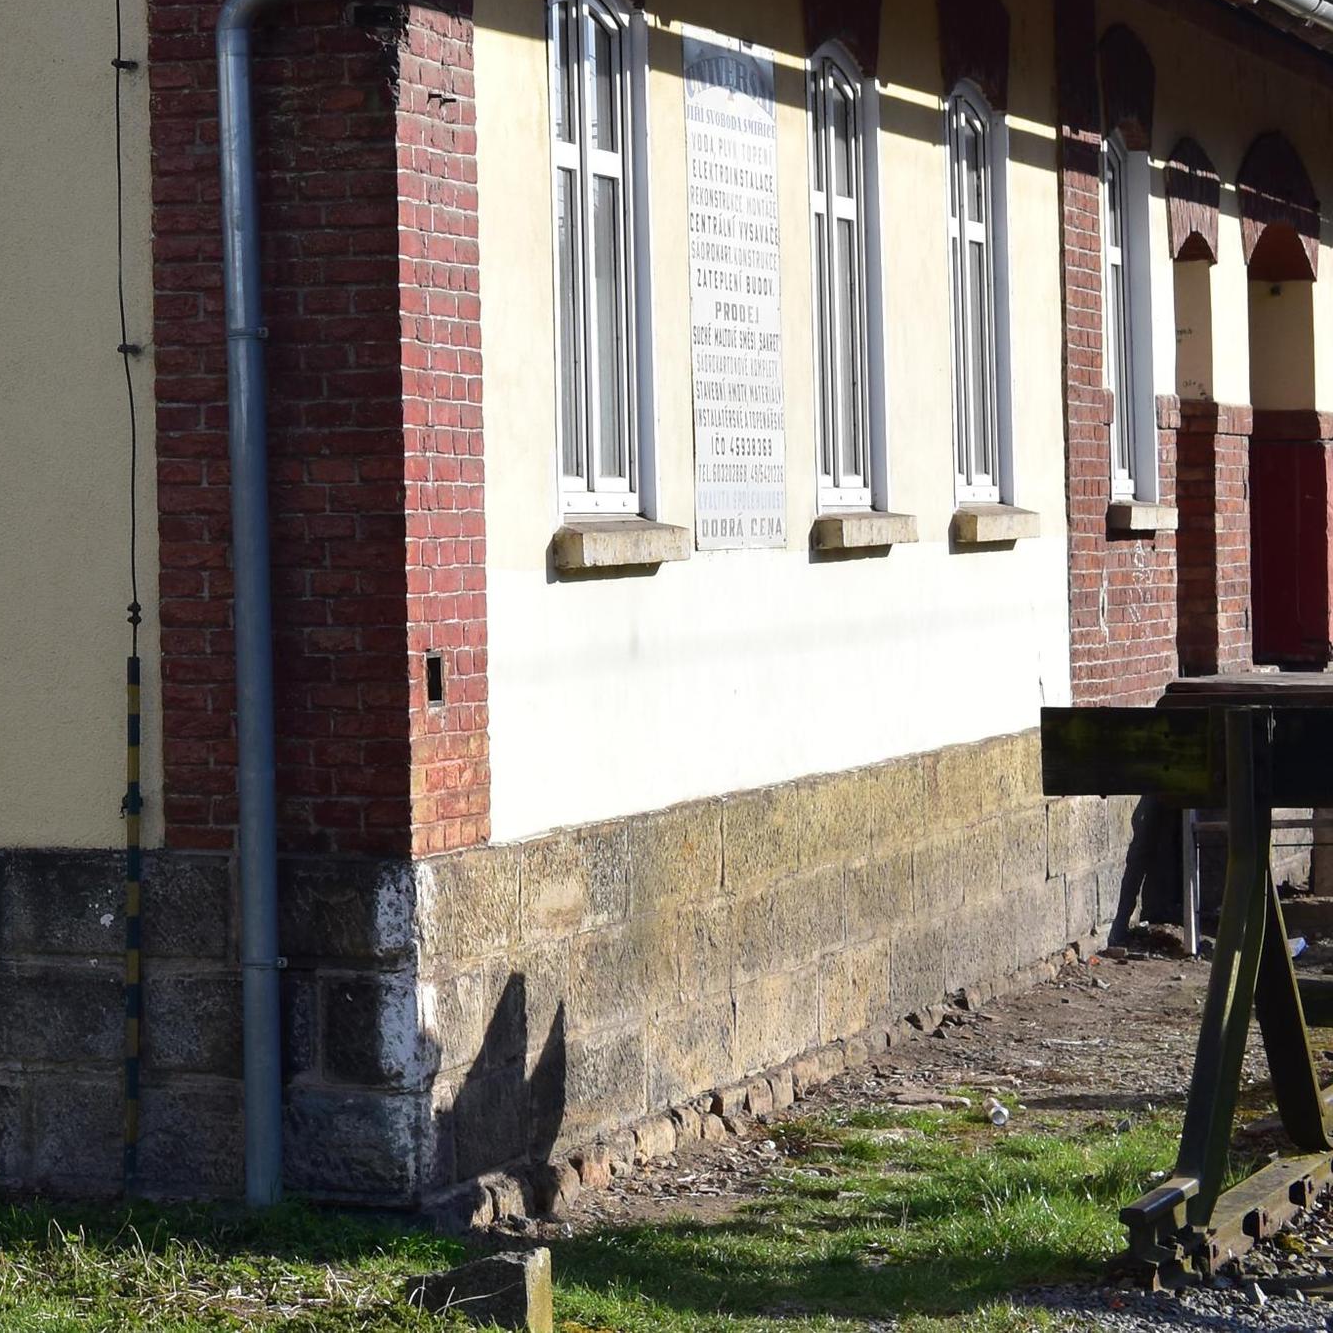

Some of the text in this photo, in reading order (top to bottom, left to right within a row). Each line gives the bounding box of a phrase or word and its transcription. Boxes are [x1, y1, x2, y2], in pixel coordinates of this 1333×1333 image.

[685, 56, 775, 119] UNIVERSAL
[697, 268, 742, 292] ZATEPLENÍ
[715, 301, 759, 323] PRODEJ
[711, 432, 725, 456] IČO
[701, 512, 744, 537] DOBRÁ
